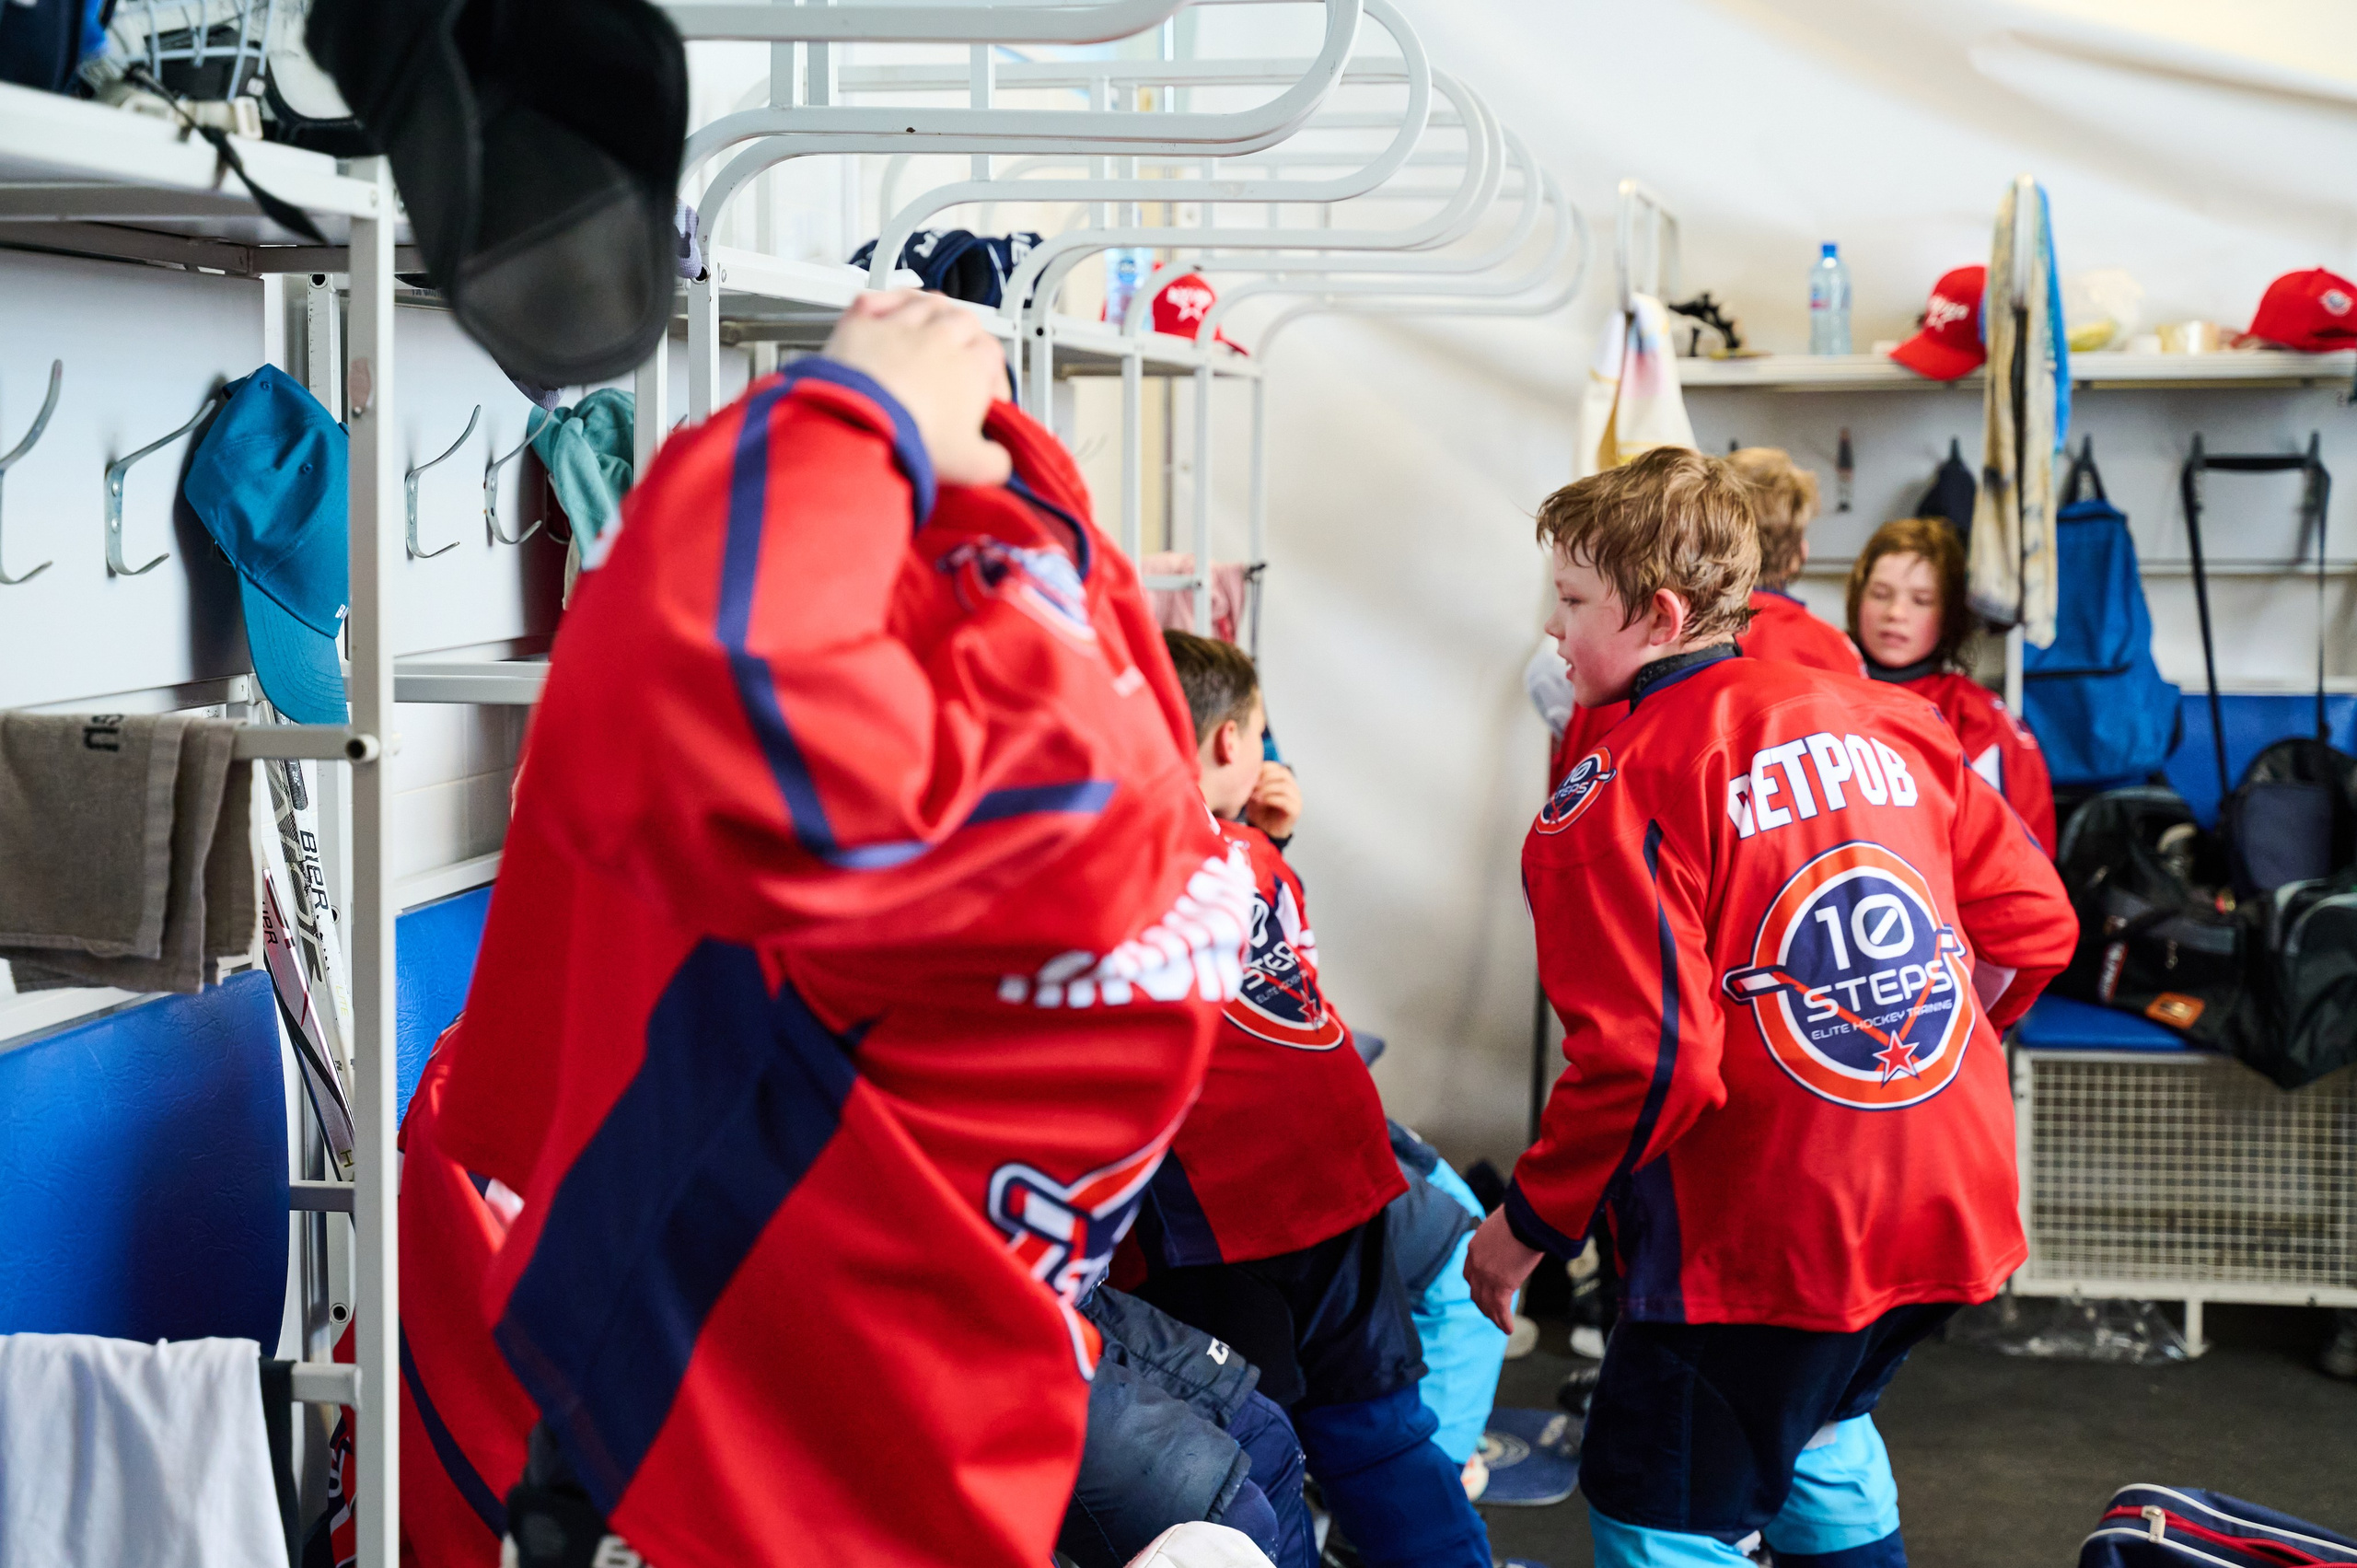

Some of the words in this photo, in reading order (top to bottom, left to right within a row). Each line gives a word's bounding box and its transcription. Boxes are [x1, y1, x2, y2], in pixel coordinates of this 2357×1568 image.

[1815, 893, 1914, 970] 10
[1803, 959, 1953, 1023] STEPS
[1811, 1023, 1851, 1040] ELITE
[1852, 1010, 1906, 1030] HOCKEY
[1906, 999, 1953, 1017] TRAINING
